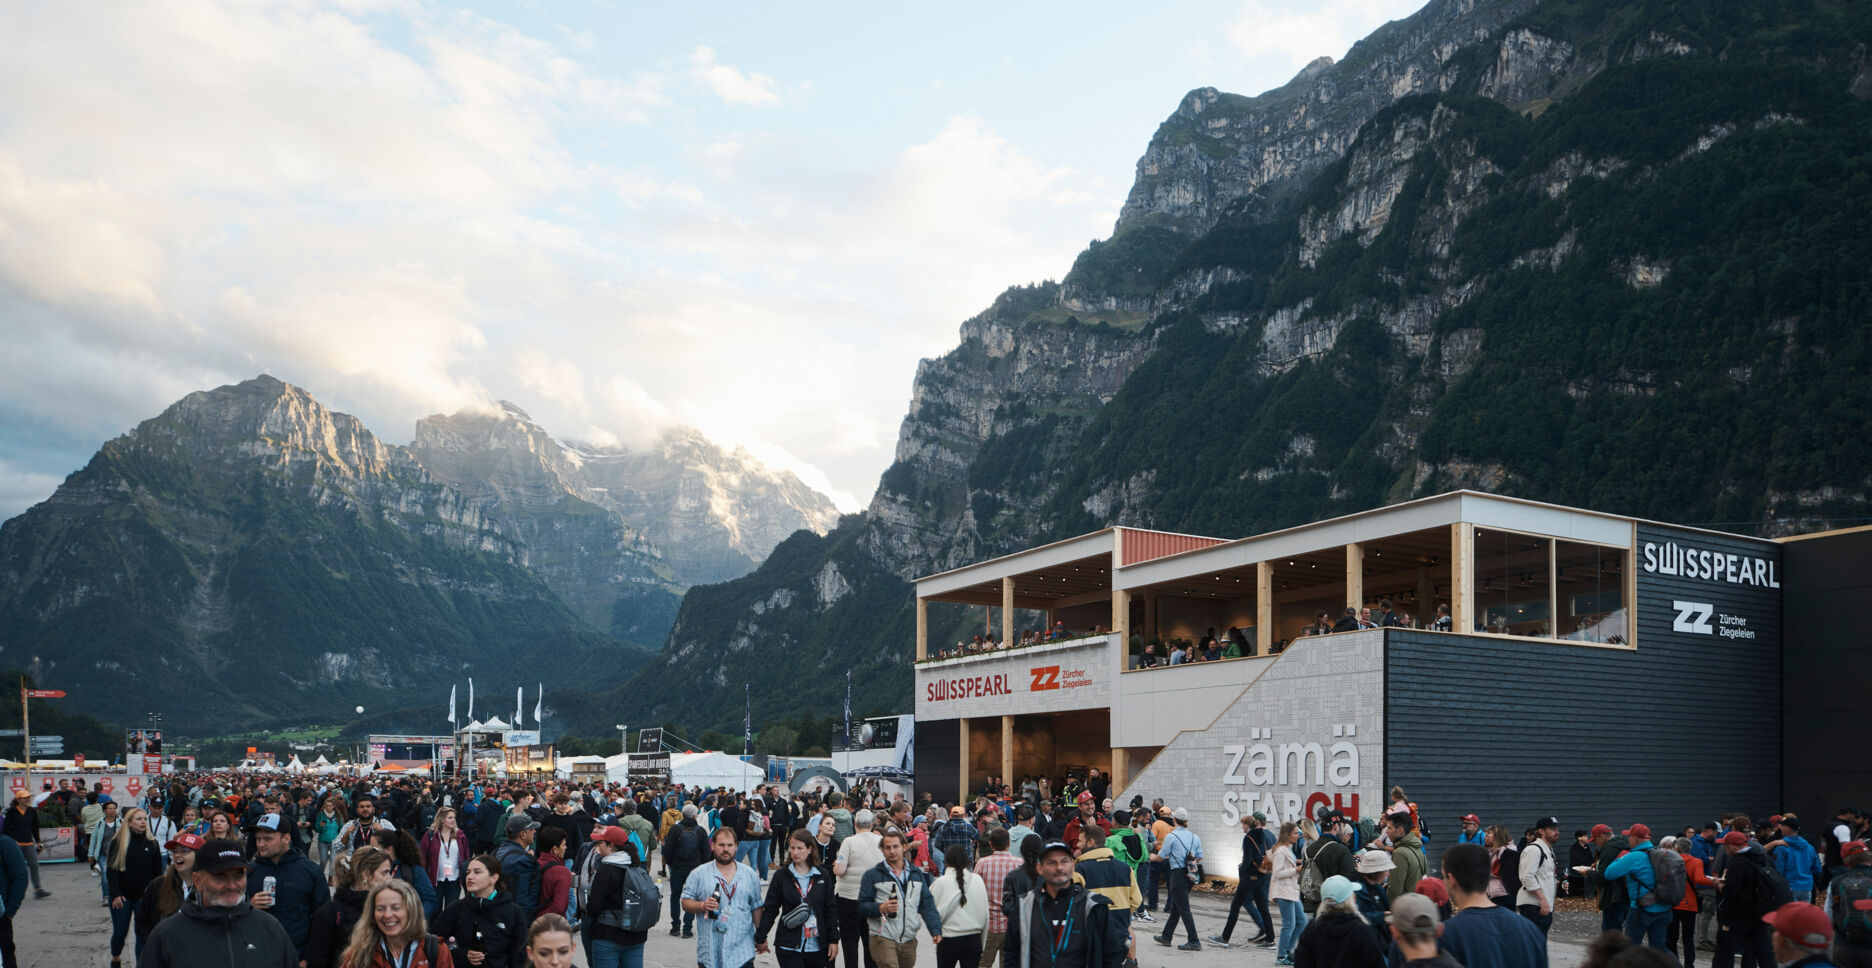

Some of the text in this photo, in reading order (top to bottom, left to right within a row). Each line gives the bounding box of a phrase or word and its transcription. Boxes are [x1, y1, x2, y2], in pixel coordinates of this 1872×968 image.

[1643, 541, 1780, 589] SWISSPEARL
[1673, 600, 1713, 634] ZZ
[1719, 613, 1746, 626] Zürcher
[1719, 626, 1755, 639] Ziegeleien
[1030, 665, 1060, 692] ZZ
[1062, 669, 1085, 679] Zürcher
[1062, 678, 1093, 690] Ziegeleien
[927, 674, 1012, 702] SWISSPEARL
[1223, 724, 1360, 786] zämä
